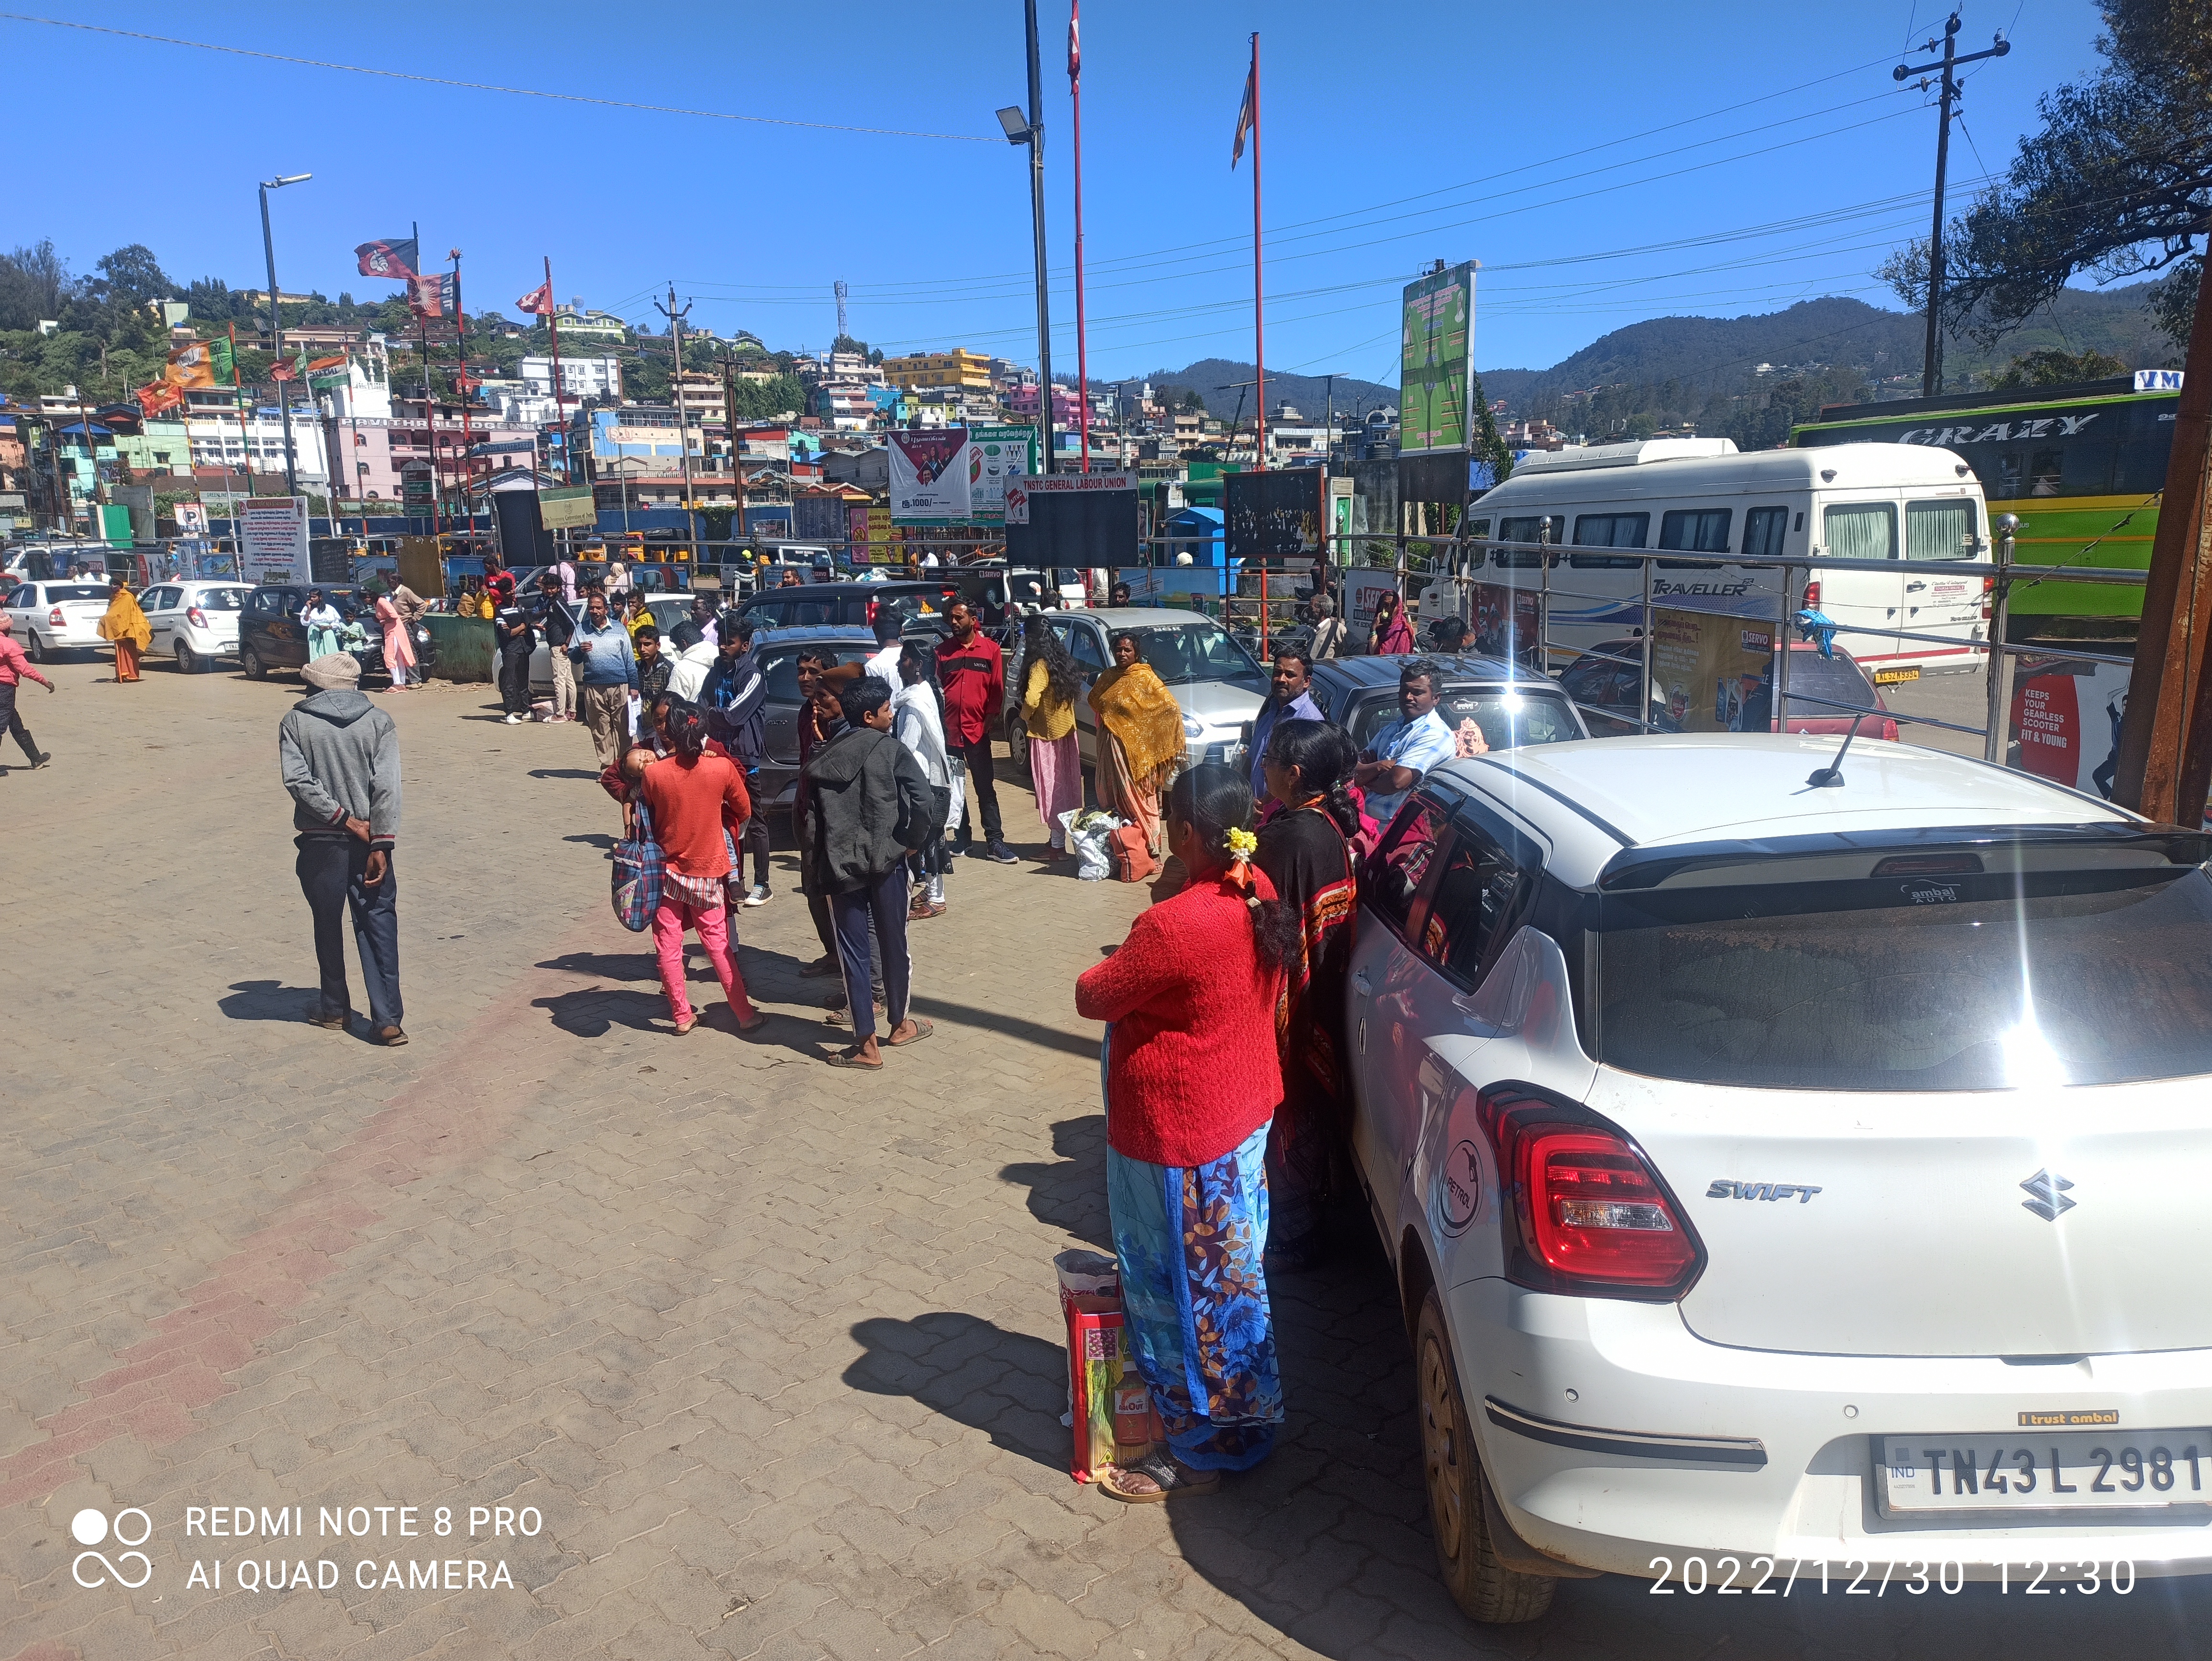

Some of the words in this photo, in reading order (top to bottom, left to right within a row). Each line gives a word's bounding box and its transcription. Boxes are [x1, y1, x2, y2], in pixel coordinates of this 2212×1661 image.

[342, 418, 440, 427] PAVITHRA
[446, 421, 508, 430] LODGE
[1023, 480, 1043, 491] TNSTC
[1045, 480, 1074, 490] GENERAL
[1076, 478, 1103, 489] LABOUR
[1105, 476, 1126, 487] UNION
[1010, 490, 1023, 505] AITUC
[187, 511, 197, 522] P
[89, 562, 102, 571] SERVO
[1652, 579, 1747, 596] TRAVELLER
[1364, 589, 1381, 609] SER
[1521, 595, 1534, 606] SERVO
[1748, 632, 1769, 645] SERVO
[2025, 688, 2049, 700] KEEPS
[2024, 698, 2046, 710] YOUR
[2024, 708, 2064, 723] GEARLESS
[2023, 718, 2059, 732] SCOOTER
[2021, 729, 2033, 741] FIT
[2034, 731, 2040, 743] &
[2042, 733, 2067, 748] YOUNG
[1912, 886, 1955, 897] ambal
[1446, 1175, 1470, 1209] PETROL
[1705, 1179, 1823, 1204] SWIFT
[2021, 1414, 2026, 1425] I
[2031, 1414, 2066, 1425] trust
[2070, 1412, 2117, 1424] ambal
[1891, 1466, 1915, 1479] IND
[1923, 1448, 2037, 1495] TN43
[2051, 1448, 2078, 1494] L
[2090, 1445, 2201, 1494] 2981
